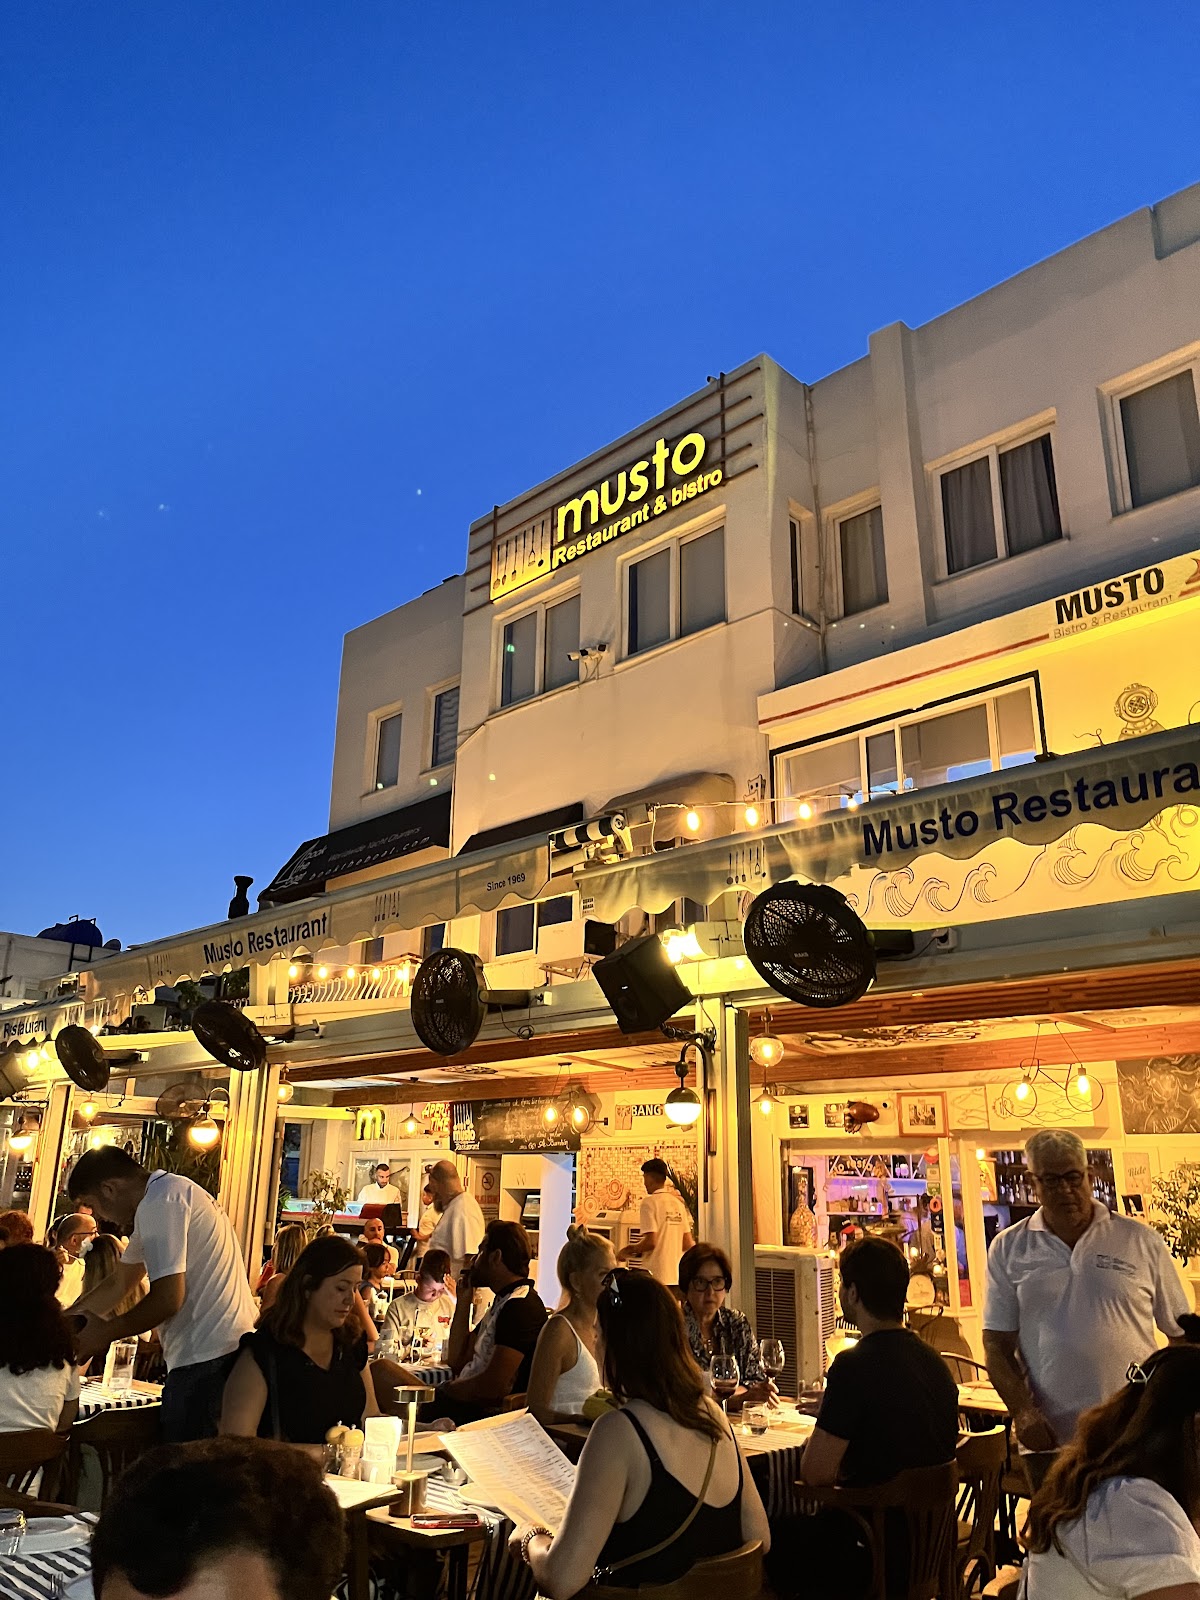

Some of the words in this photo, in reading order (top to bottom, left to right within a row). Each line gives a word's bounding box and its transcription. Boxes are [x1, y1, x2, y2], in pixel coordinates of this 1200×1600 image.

[556, 432, 706, 542] musto
[551, 502, 650, 570] Restaurant
[653, 494, 667, 515] &
[671, 468, 723, 507] bistro
[1053, 621, 1088, 639] Bistro
[1091, 616, 1100, 627] &
[1103, 594, 1173, 623] Restaurant
[1055, 567, 1165, 625] MUSTO
[862, 805, 979, 856] Musto
[991, 762, 1200, 830] Restaura
[486, 881, 506, 891] Since
[507, 872, 526, 886] 1969
[247, 912, 328, 954] Restaurant
[631, 1104, 661, 1117] BANG
